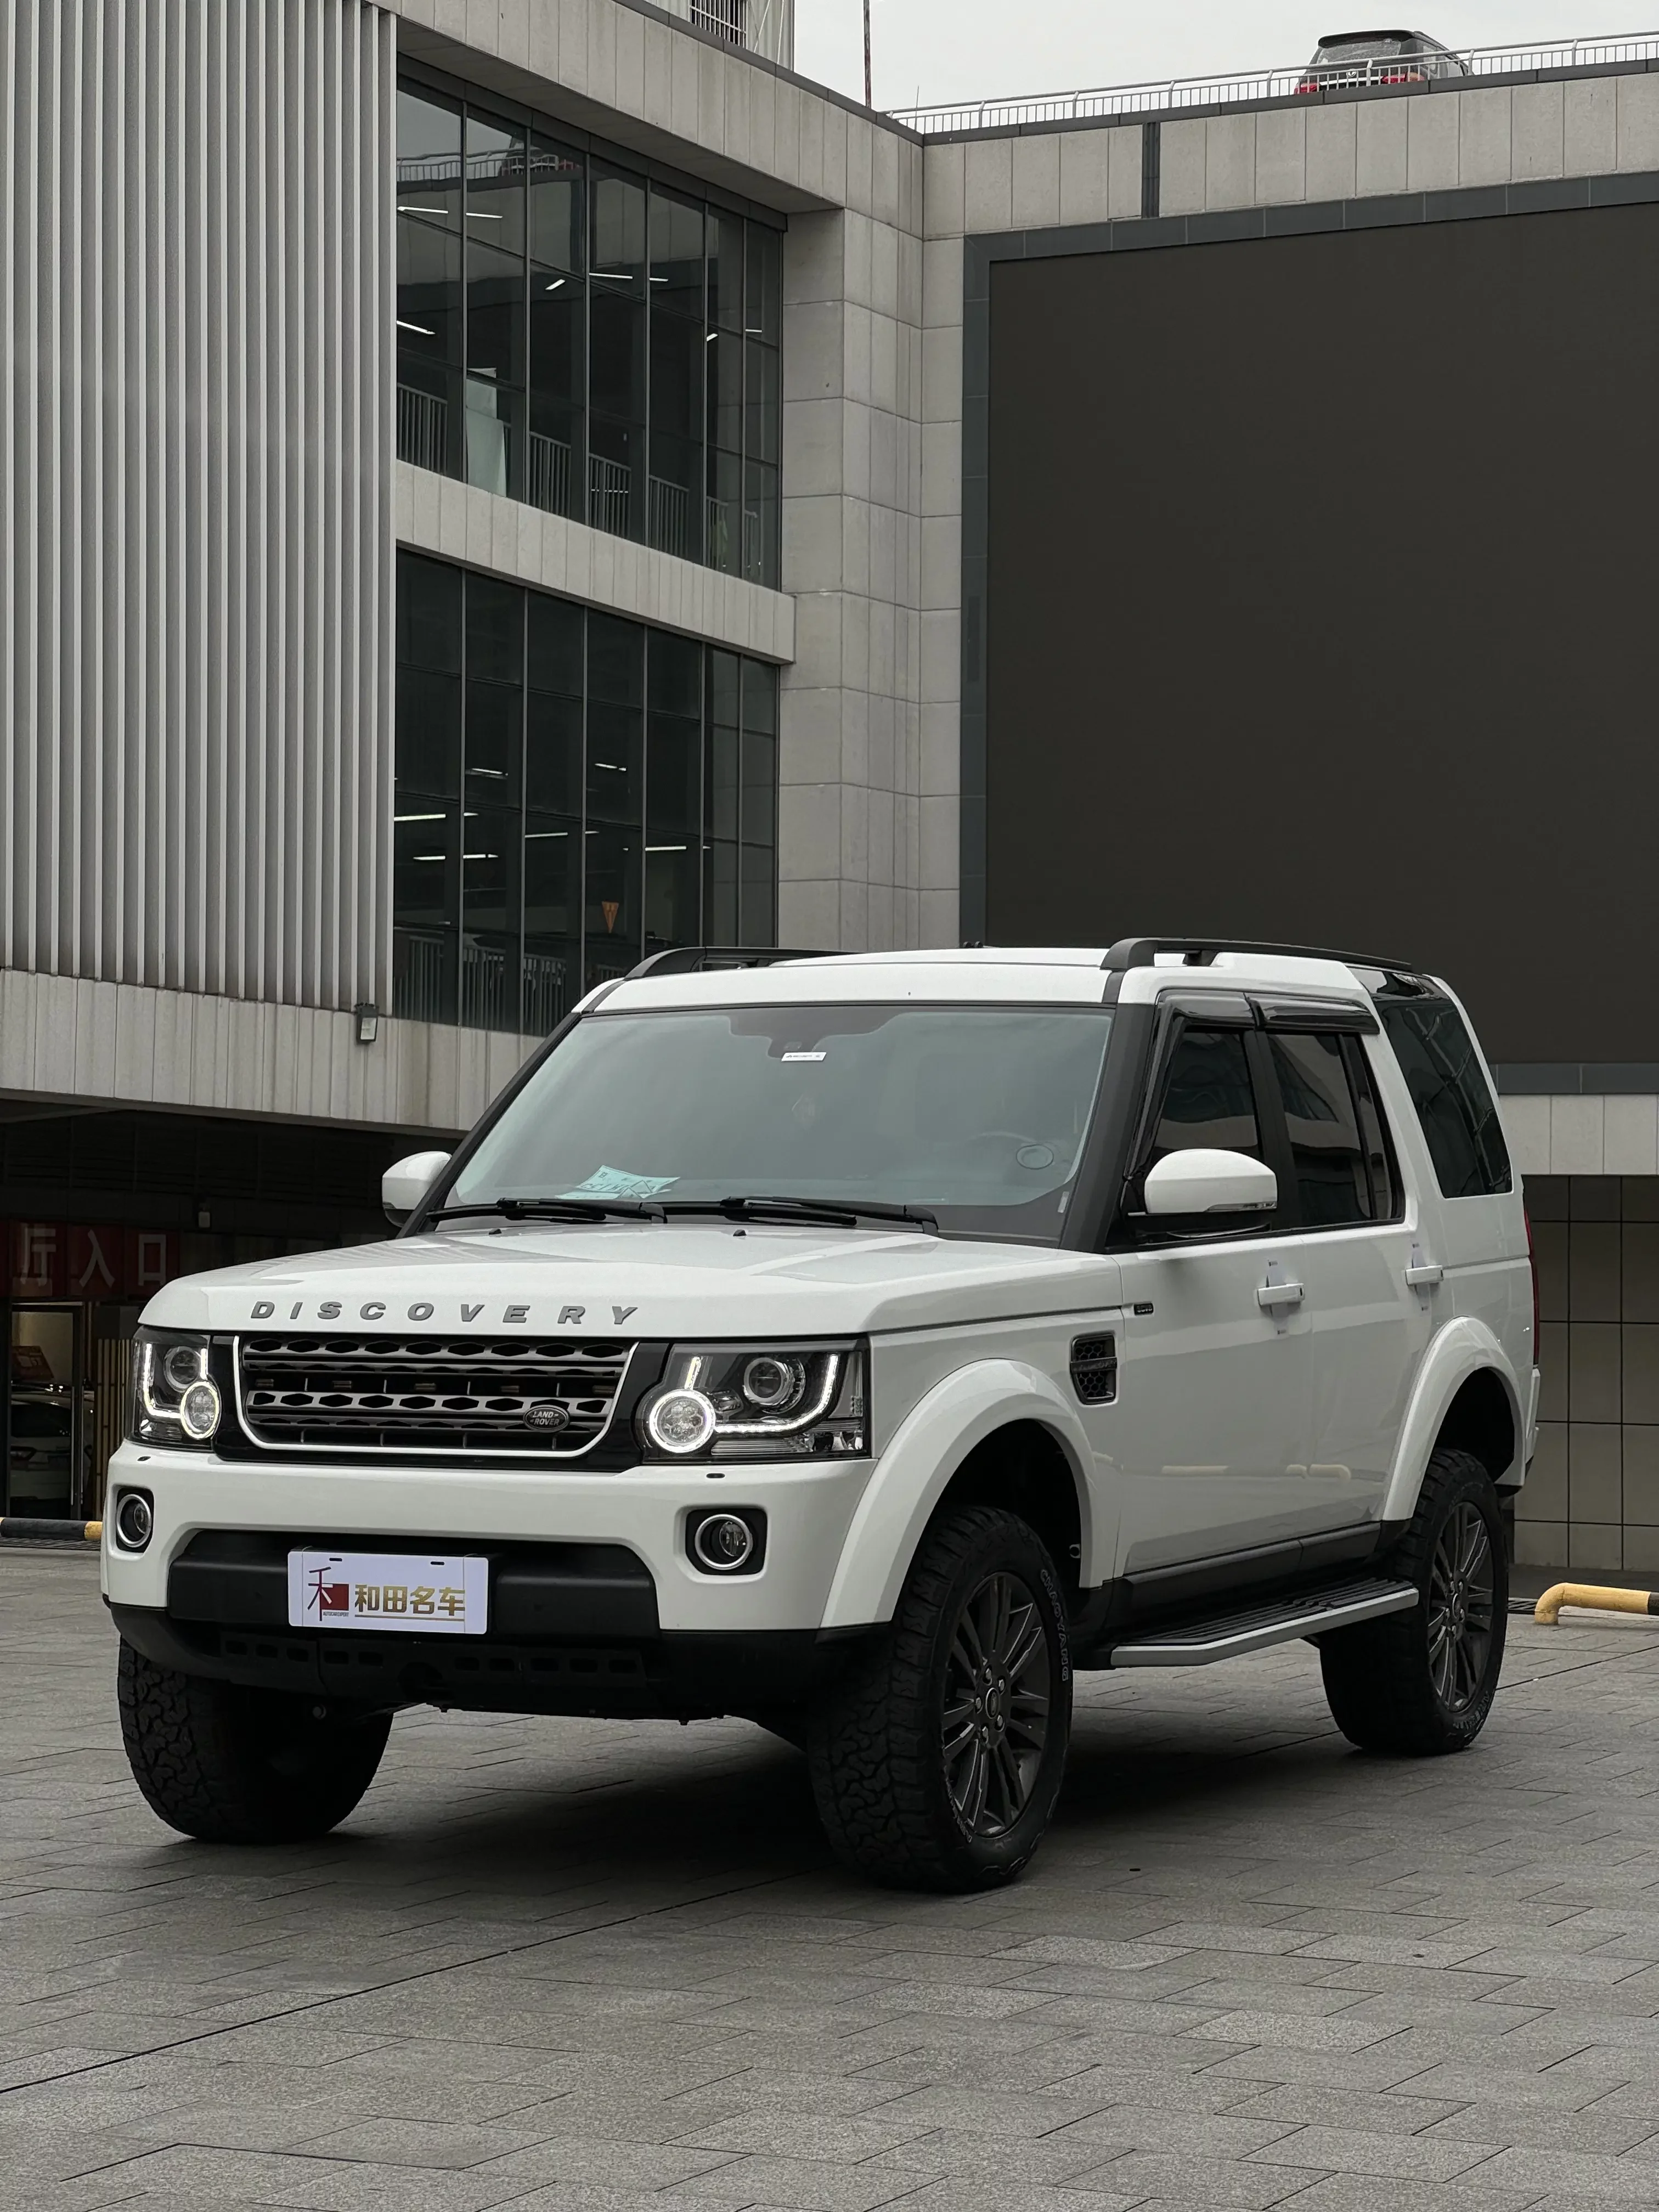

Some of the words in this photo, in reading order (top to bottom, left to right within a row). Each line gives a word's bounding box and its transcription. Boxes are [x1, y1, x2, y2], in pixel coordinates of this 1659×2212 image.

[20, 1227, 166, 1288] 厅入口
[251, 1301, 638, 1325] DISCOVERY
[354, 1584, 466, 1616] 和田名车
[1040, 1568, 1069, 1681] CHAOYANG
